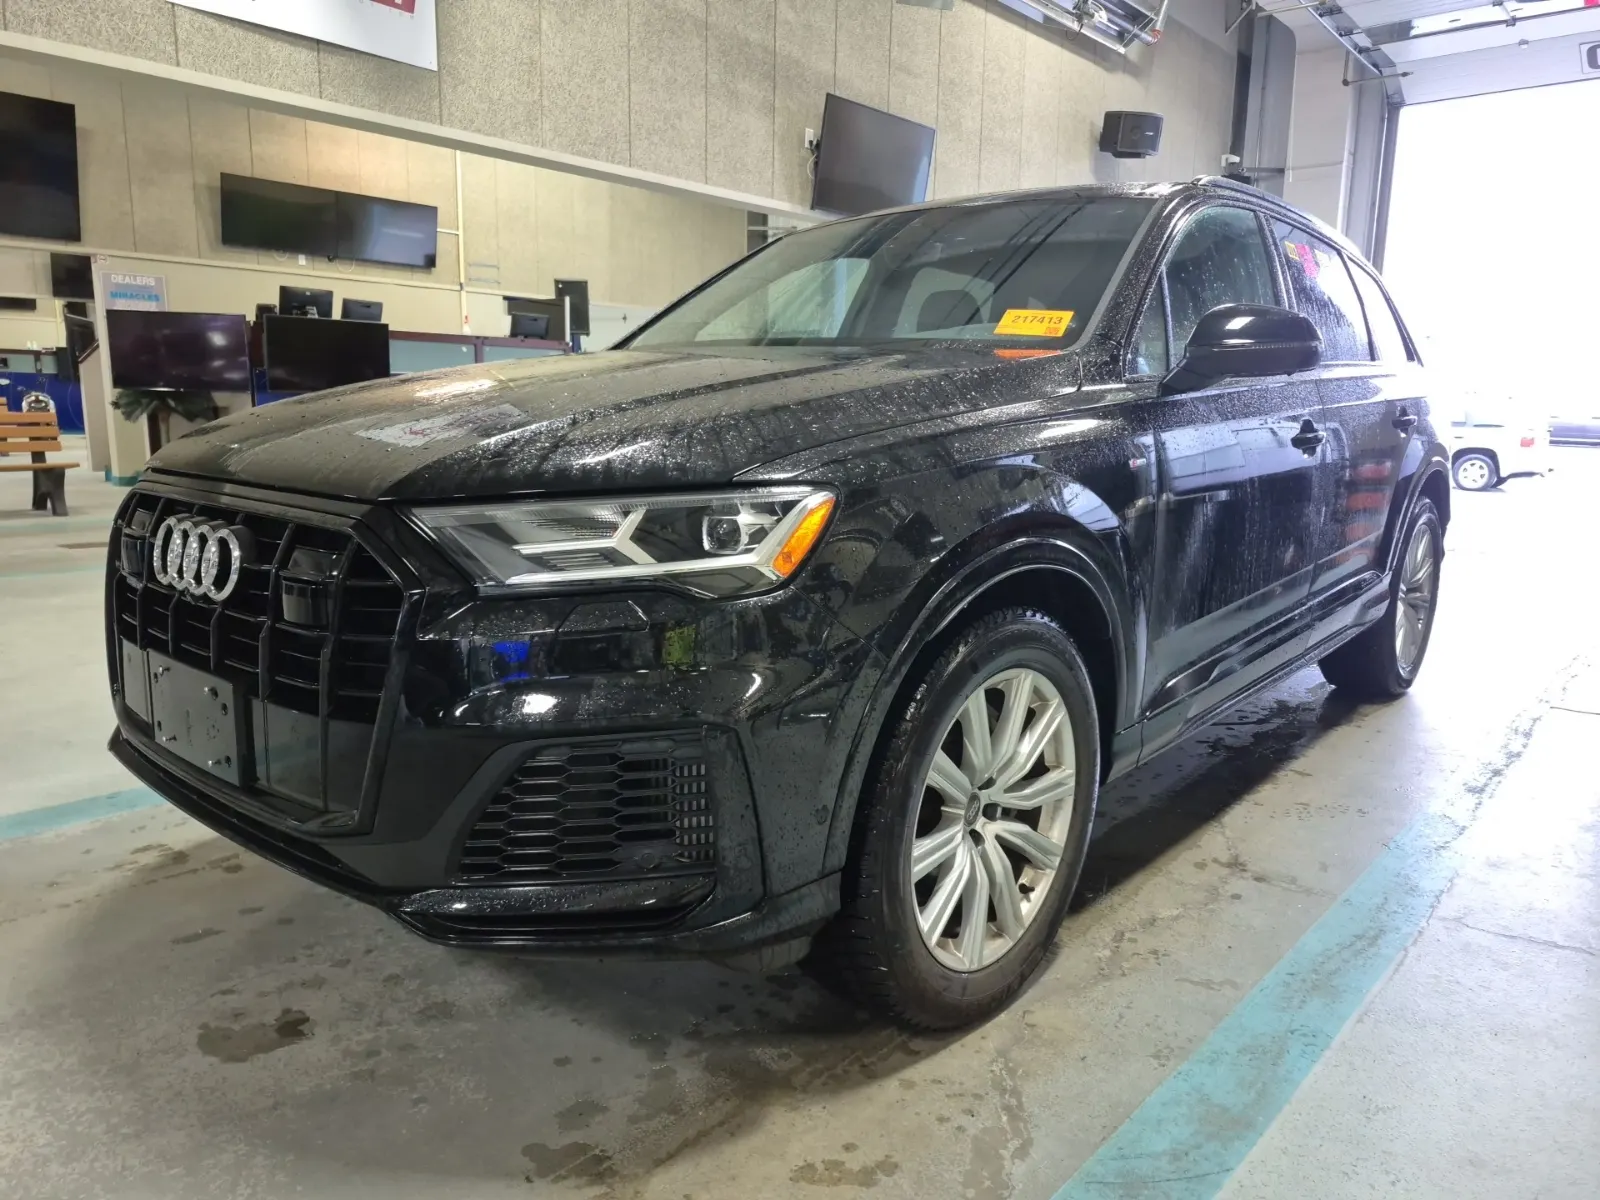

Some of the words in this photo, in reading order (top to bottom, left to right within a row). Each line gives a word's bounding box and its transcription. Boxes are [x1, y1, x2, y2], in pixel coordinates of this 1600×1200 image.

[111, 274, 155, 286] DEALERS
[110, 291, 160, 302] MIRACLES
[1011, 315, 1064, 325] 217413
